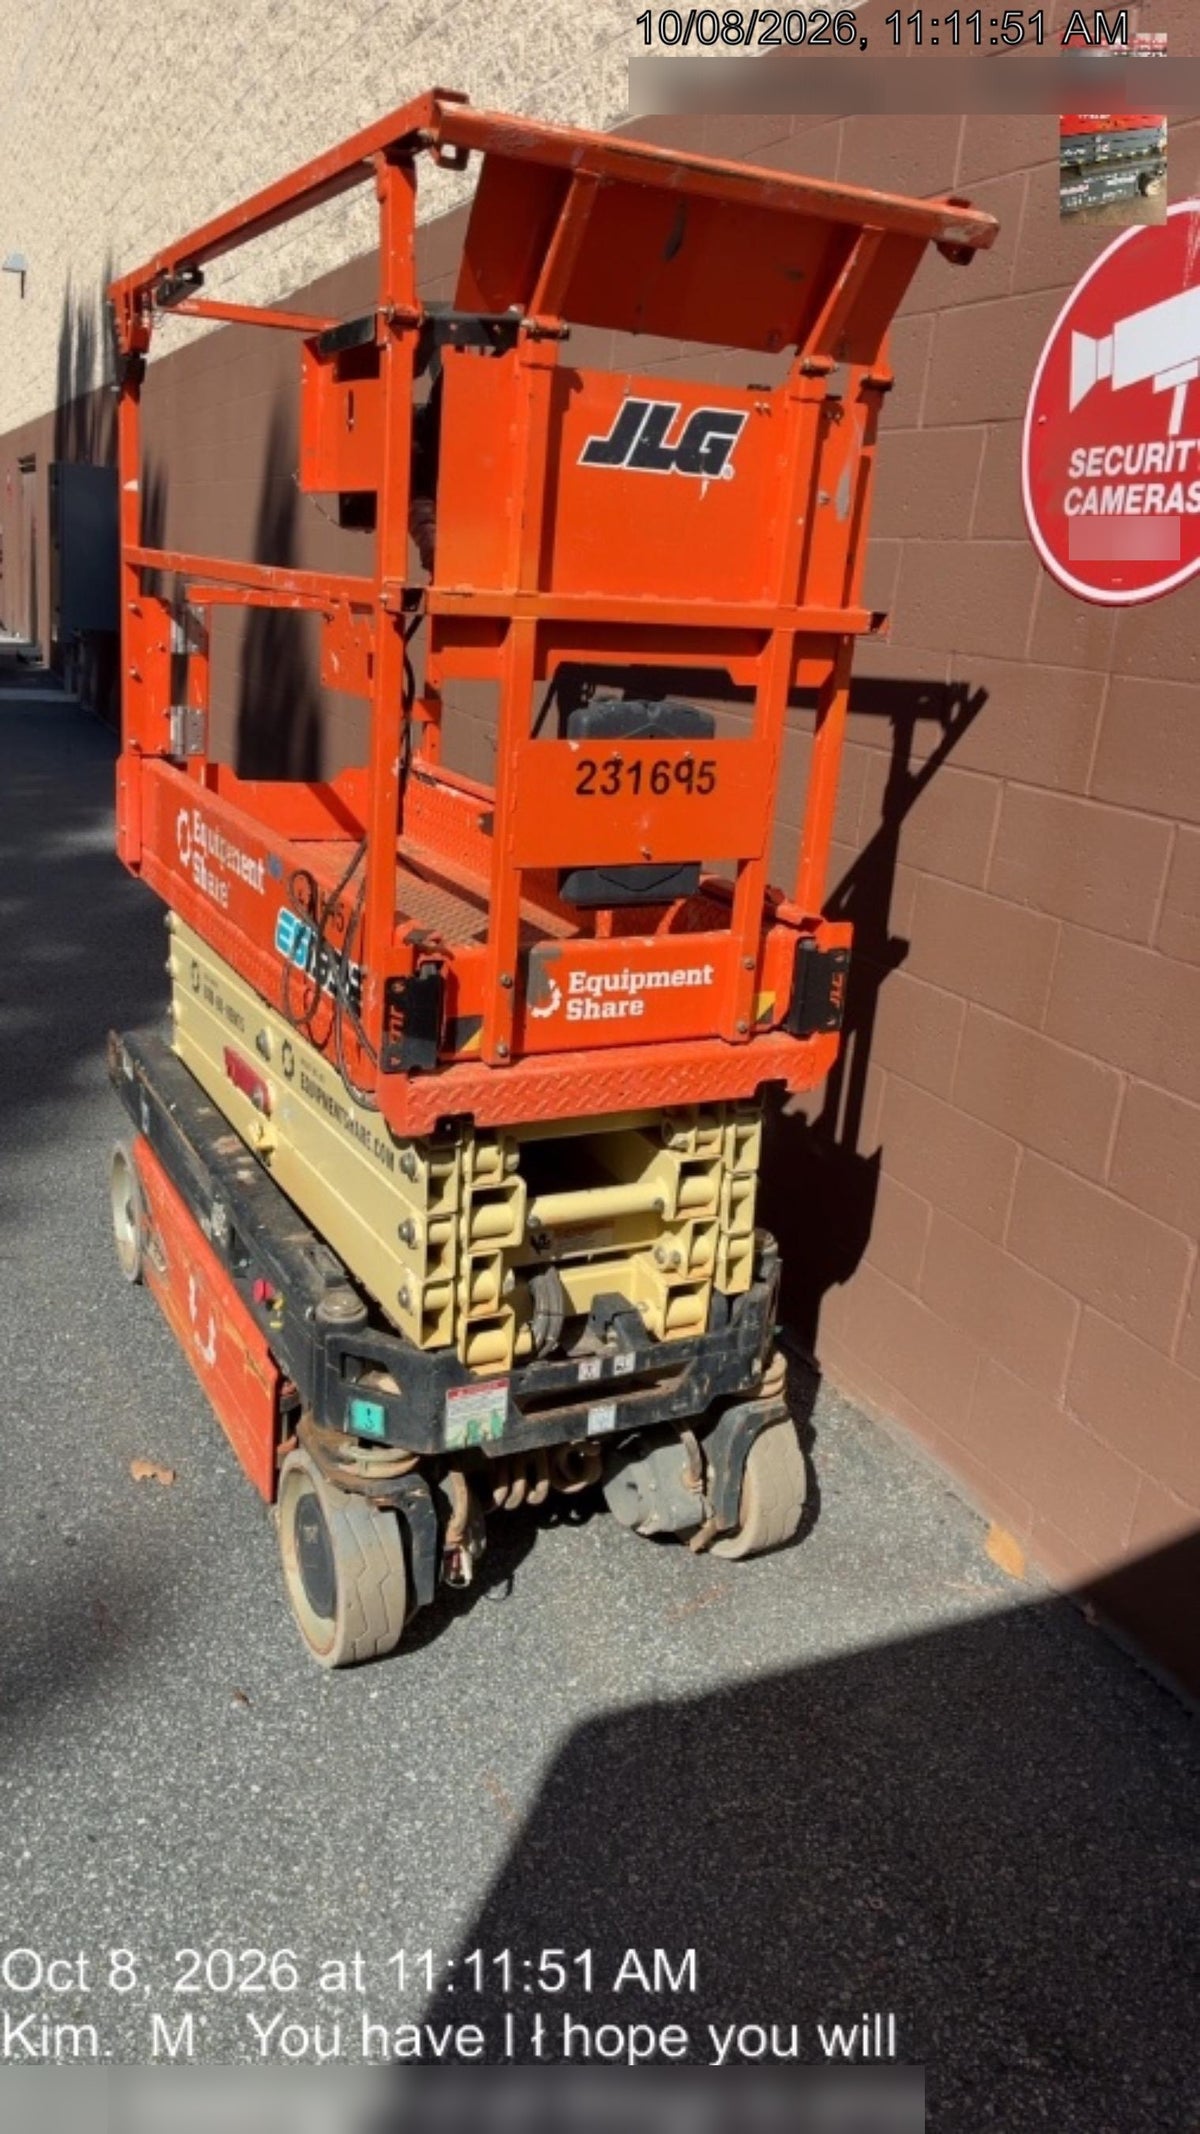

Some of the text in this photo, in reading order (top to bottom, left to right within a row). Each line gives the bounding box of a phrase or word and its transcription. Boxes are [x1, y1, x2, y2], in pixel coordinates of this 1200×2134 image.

[577, 397, 749, 479] JLG
[1068, 438, 1200, 478] SECURIT
[1064, 480, 1200, 516] CAMERAS
[576, 760, 716, 795] 231695
[193, 809, 265, 896] Equipment
[192, 850, 230, 909] Share
[568, 964, 714, 997] Equipment
[565, 998, 644, 1021] Share
